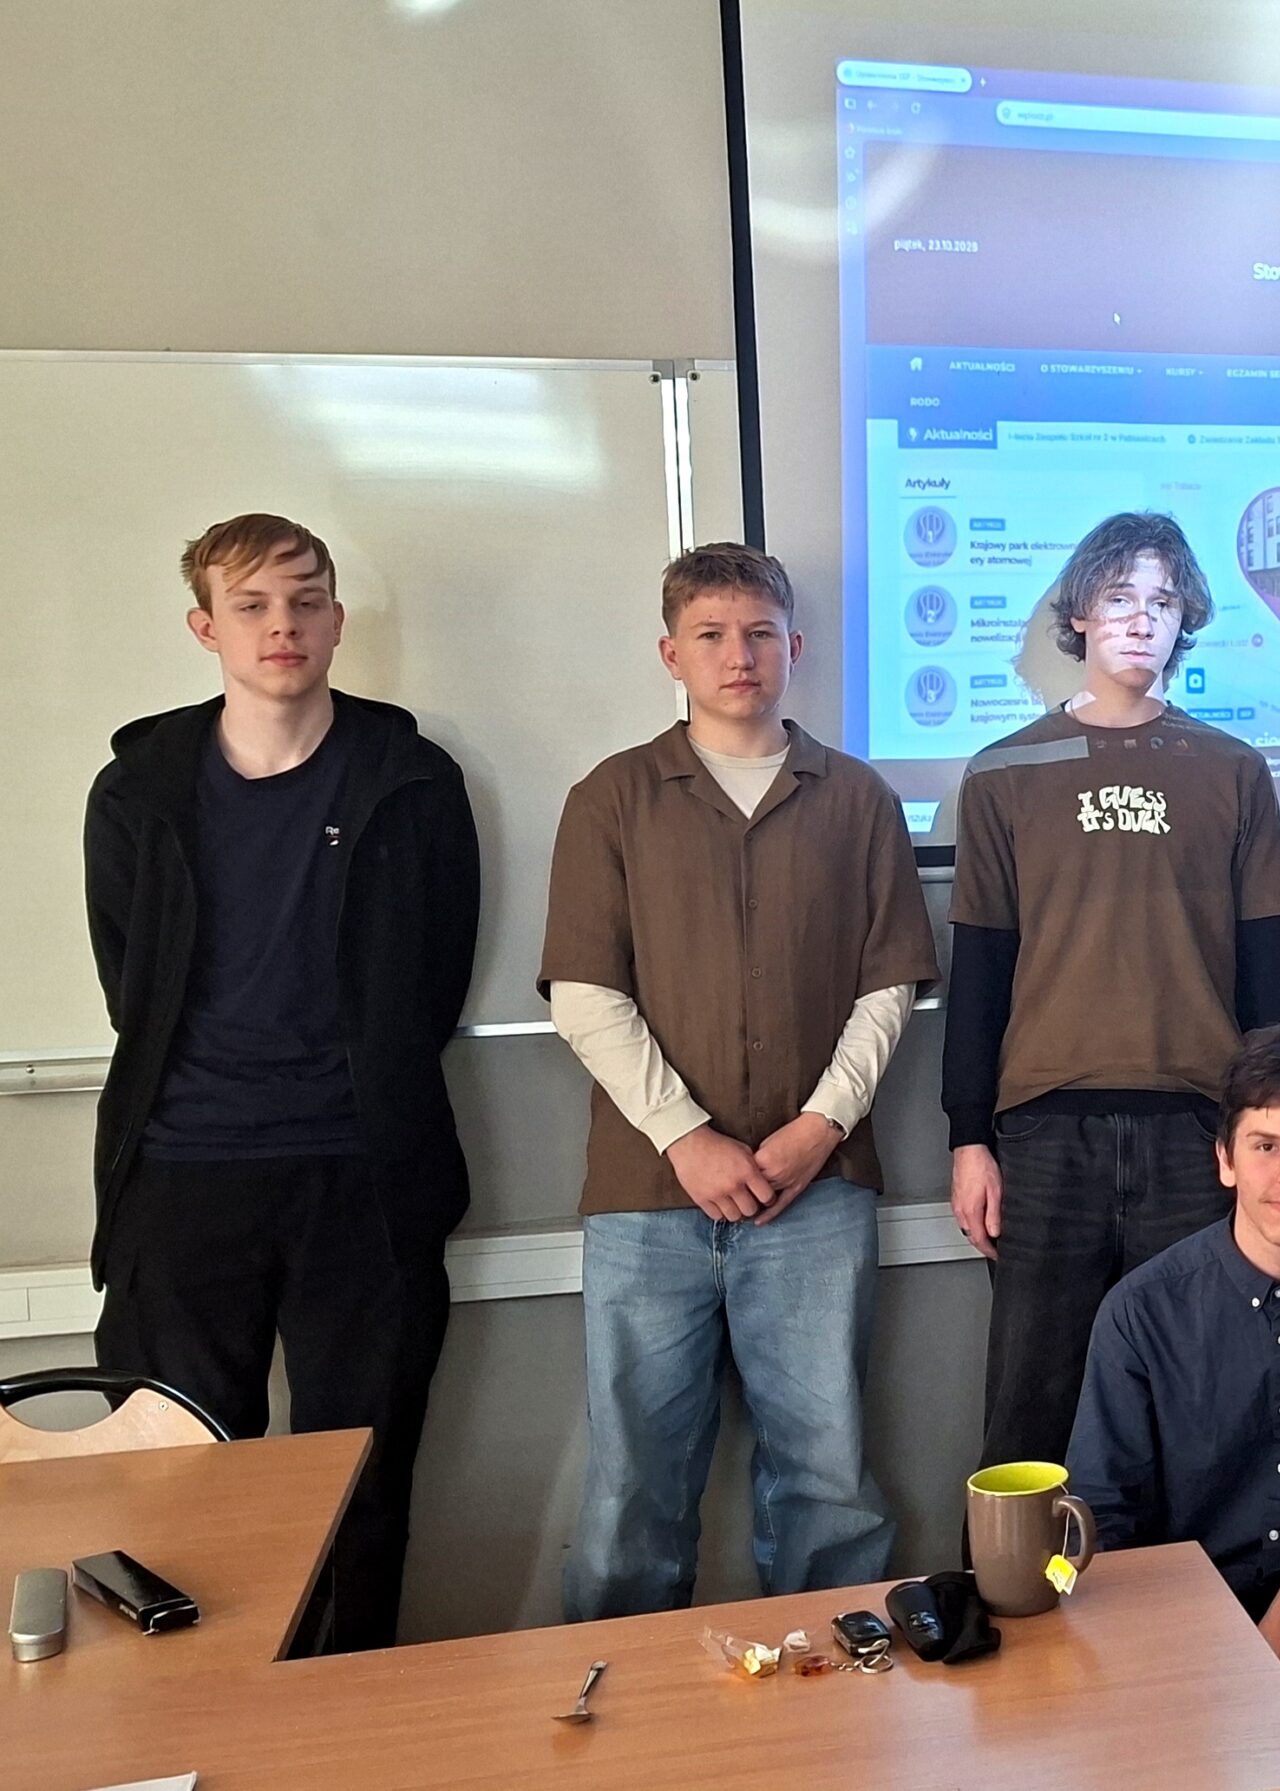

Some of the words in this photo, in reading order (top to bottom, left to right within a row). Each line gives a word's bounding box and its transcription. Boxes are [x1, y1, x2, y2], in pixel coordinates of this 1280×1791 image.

[949, 361, 1016, 373] AKTUALNOŚCI
[1041, 363, 1048, 373] O
[1051, 364, 1134, 375] STOWARZYSZENIU
[1166, 367, 1195, 377] KURSY
[1226, 368, 1268, 378] EGZAMIN
[910, 397, 940, 408] RODO
[923, 427, 993, 442] Aktualności
[905, 476, 951, 491] Artykuły
[970, 540, 1006, 552] Krajowy
[1009, 541, 1028, 551] park
[970, 555, 985, 566] ery
[987, 554, 1032, 567] atomowej
[1078, 791, 1094, 814] I
[1098, 785, 1167, 812] GUESS
